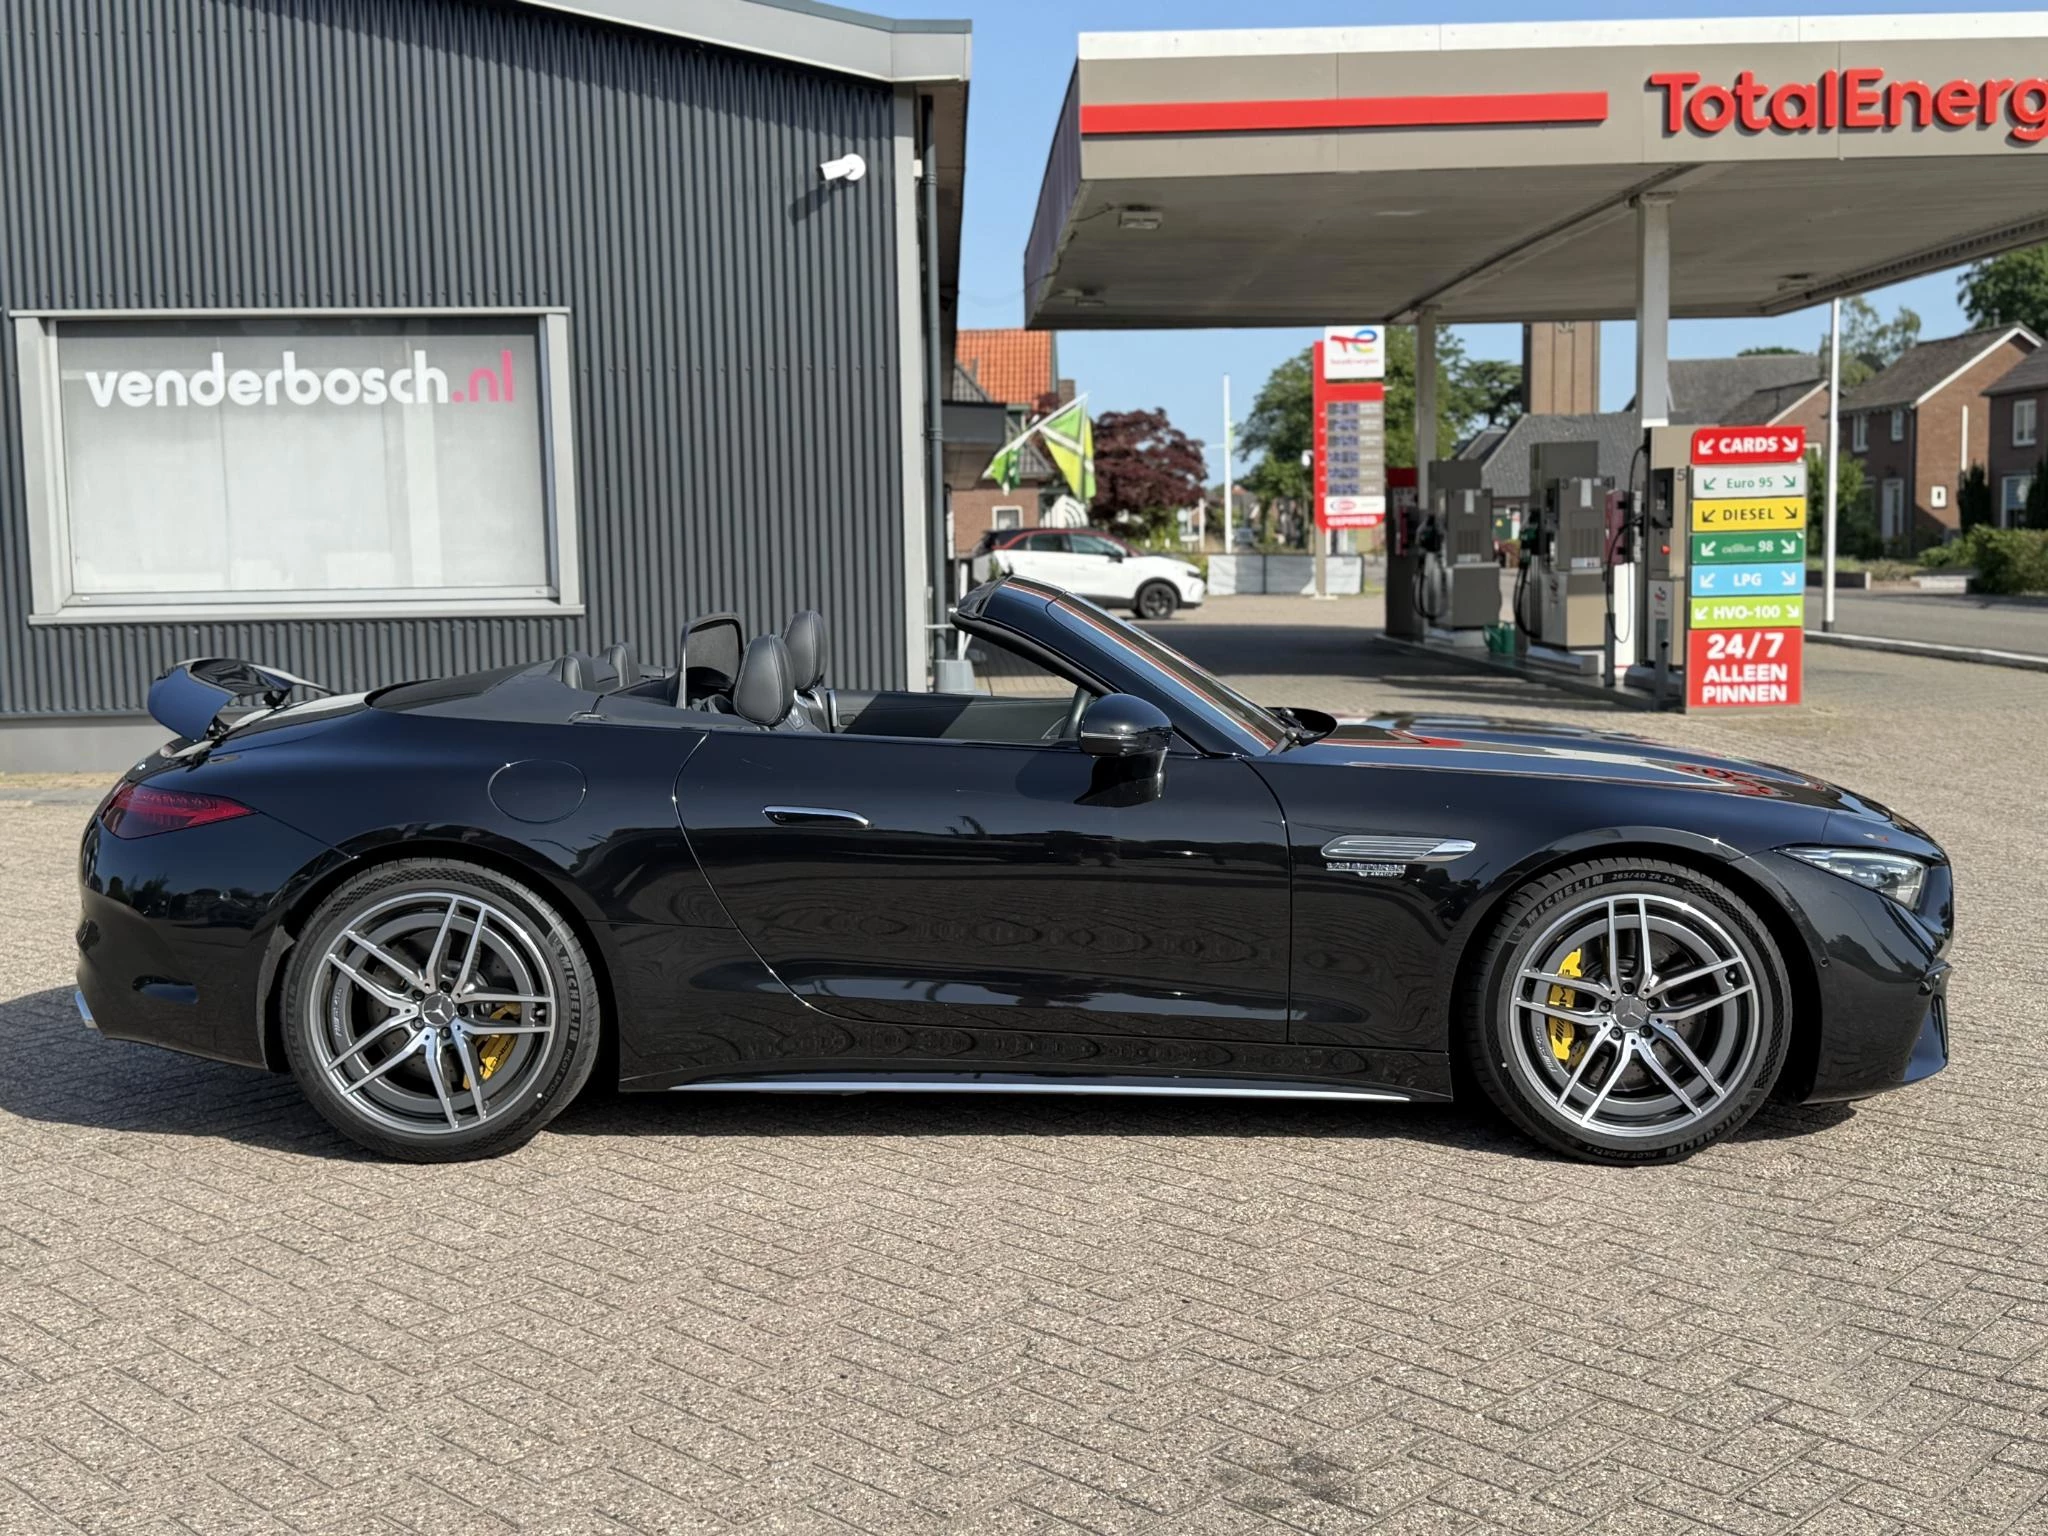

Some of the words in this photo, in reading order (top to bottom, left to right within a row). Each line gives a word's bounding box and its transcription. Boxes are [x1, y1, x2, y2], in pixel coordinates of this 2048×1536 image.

[85, 349, 514, 407] venderbosch.nl
[1719, 436, 1778, 454] CARDS
[1726, 478, 1755, 489] Euro
[1758, 477, 1773, 488] 95
[1722, 508, 1776, 521] DIESEL
[1758, 540, 1774, 552] 98
[1733, 573, 1762, 587] LPG
[1713, 605, 1780, 621] HVO-100
[1707, 632, 1785, 660] 24/7
[1703, 664, 1787, 684] ALLEEN
[1702, 684, 1787, 704] PINNEN
[1526, 874, 1604, 925] MICHELIN
[560, 955, 581, 1042] MICHELIN
